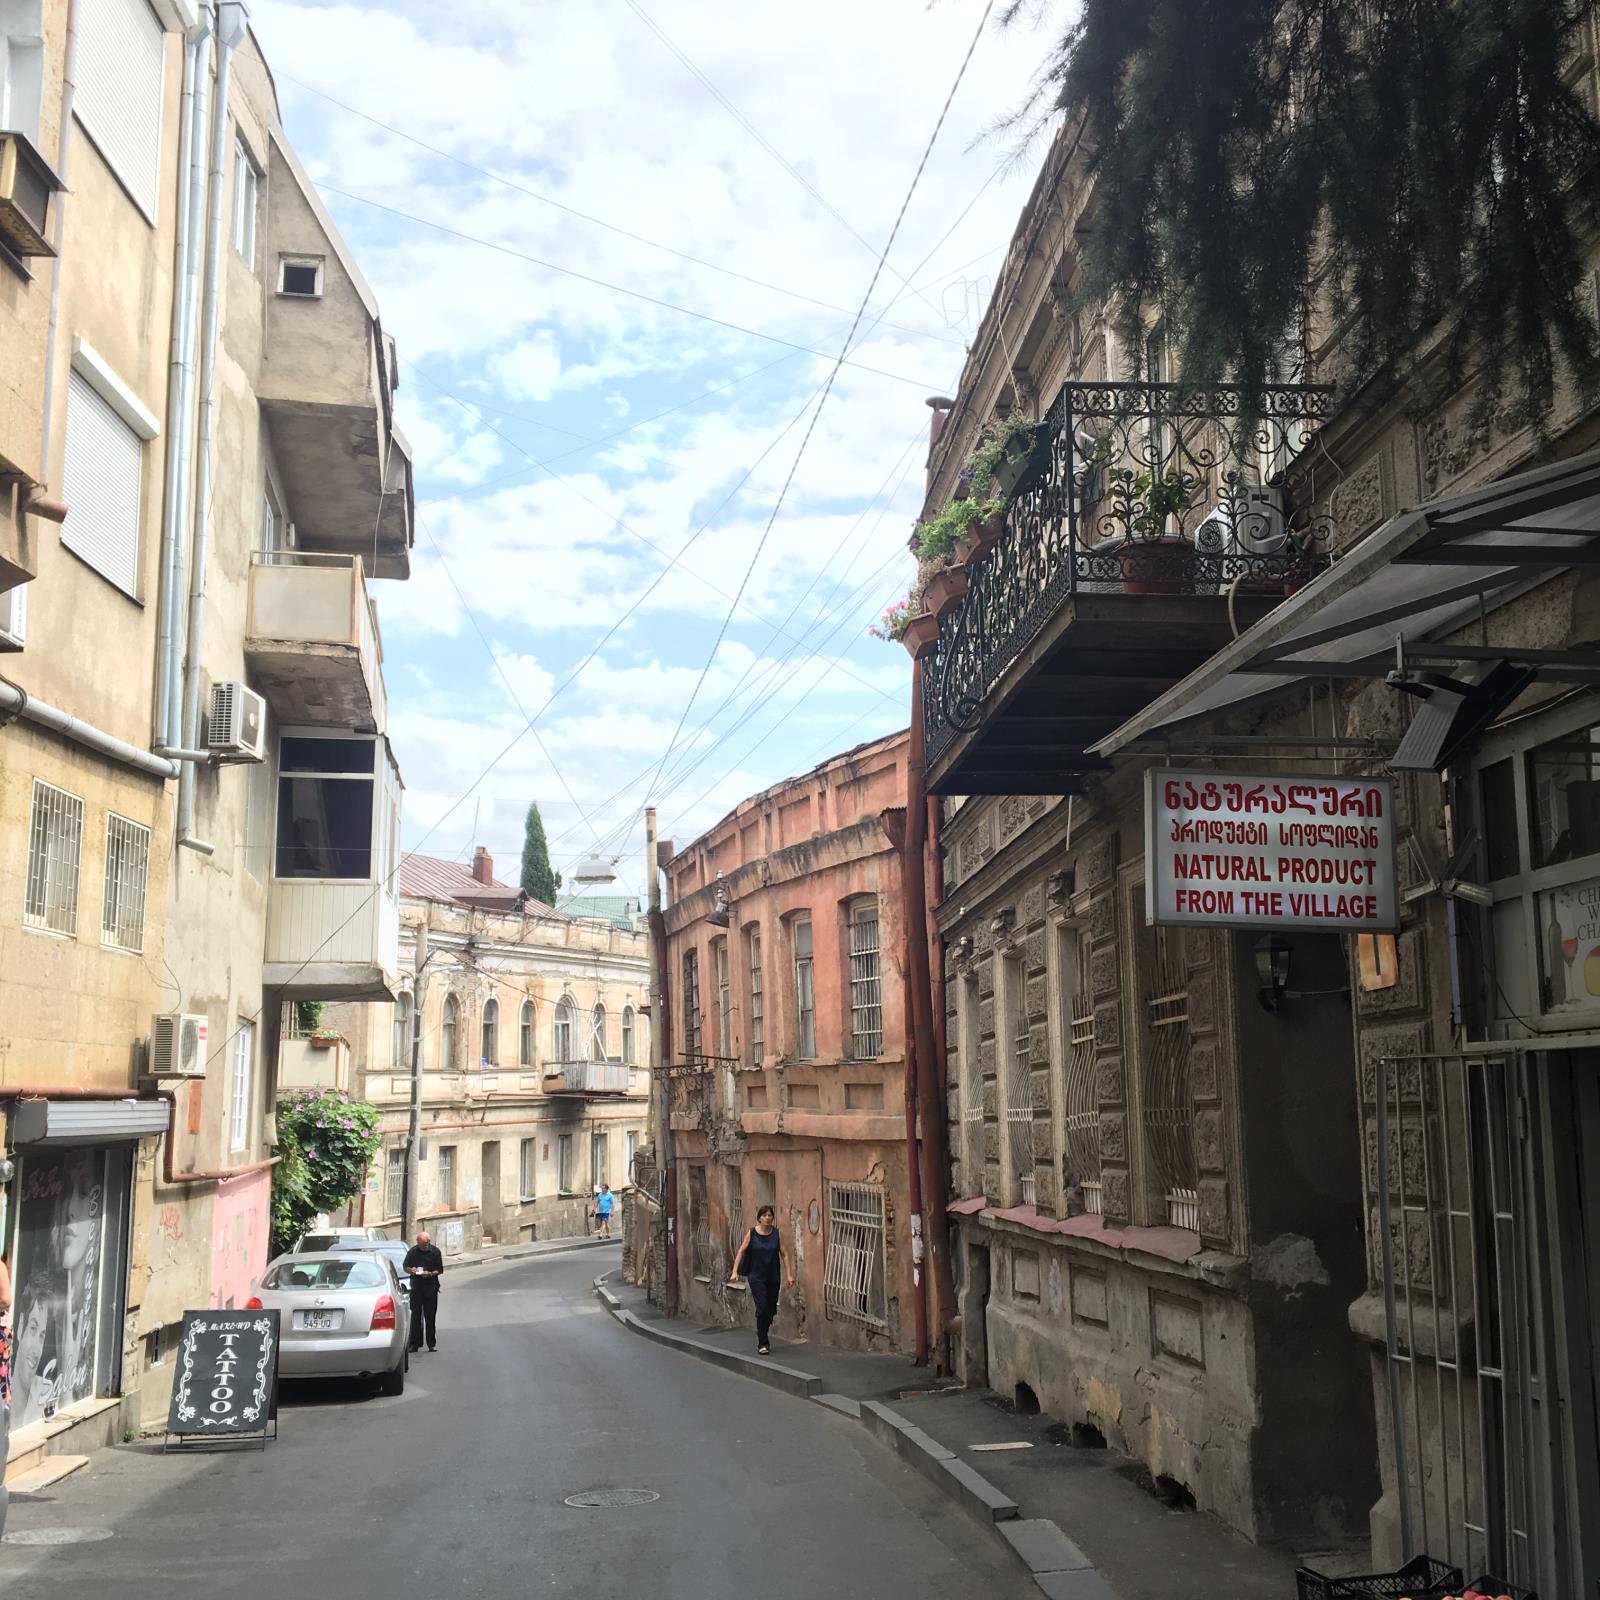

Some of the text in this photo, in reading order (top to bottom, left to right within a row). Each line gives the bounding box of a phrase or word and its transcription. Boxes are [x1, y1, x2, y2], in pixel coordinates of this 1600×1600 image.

[1164, 780, 1382, 818] ნატურალური
[1170, 818, 1379, 849] პროდუქტი სოფლიდან
[1173, 853, 1376, 885] NATURAL PRODUCT
[1175, 889, 1378, 919] FROM THE VILLAGE
[1578, 886, 1600, 906] CH
[38, 1358, 87, 1405] Salon
[209, 1334, 240, 1413] TATTOO
